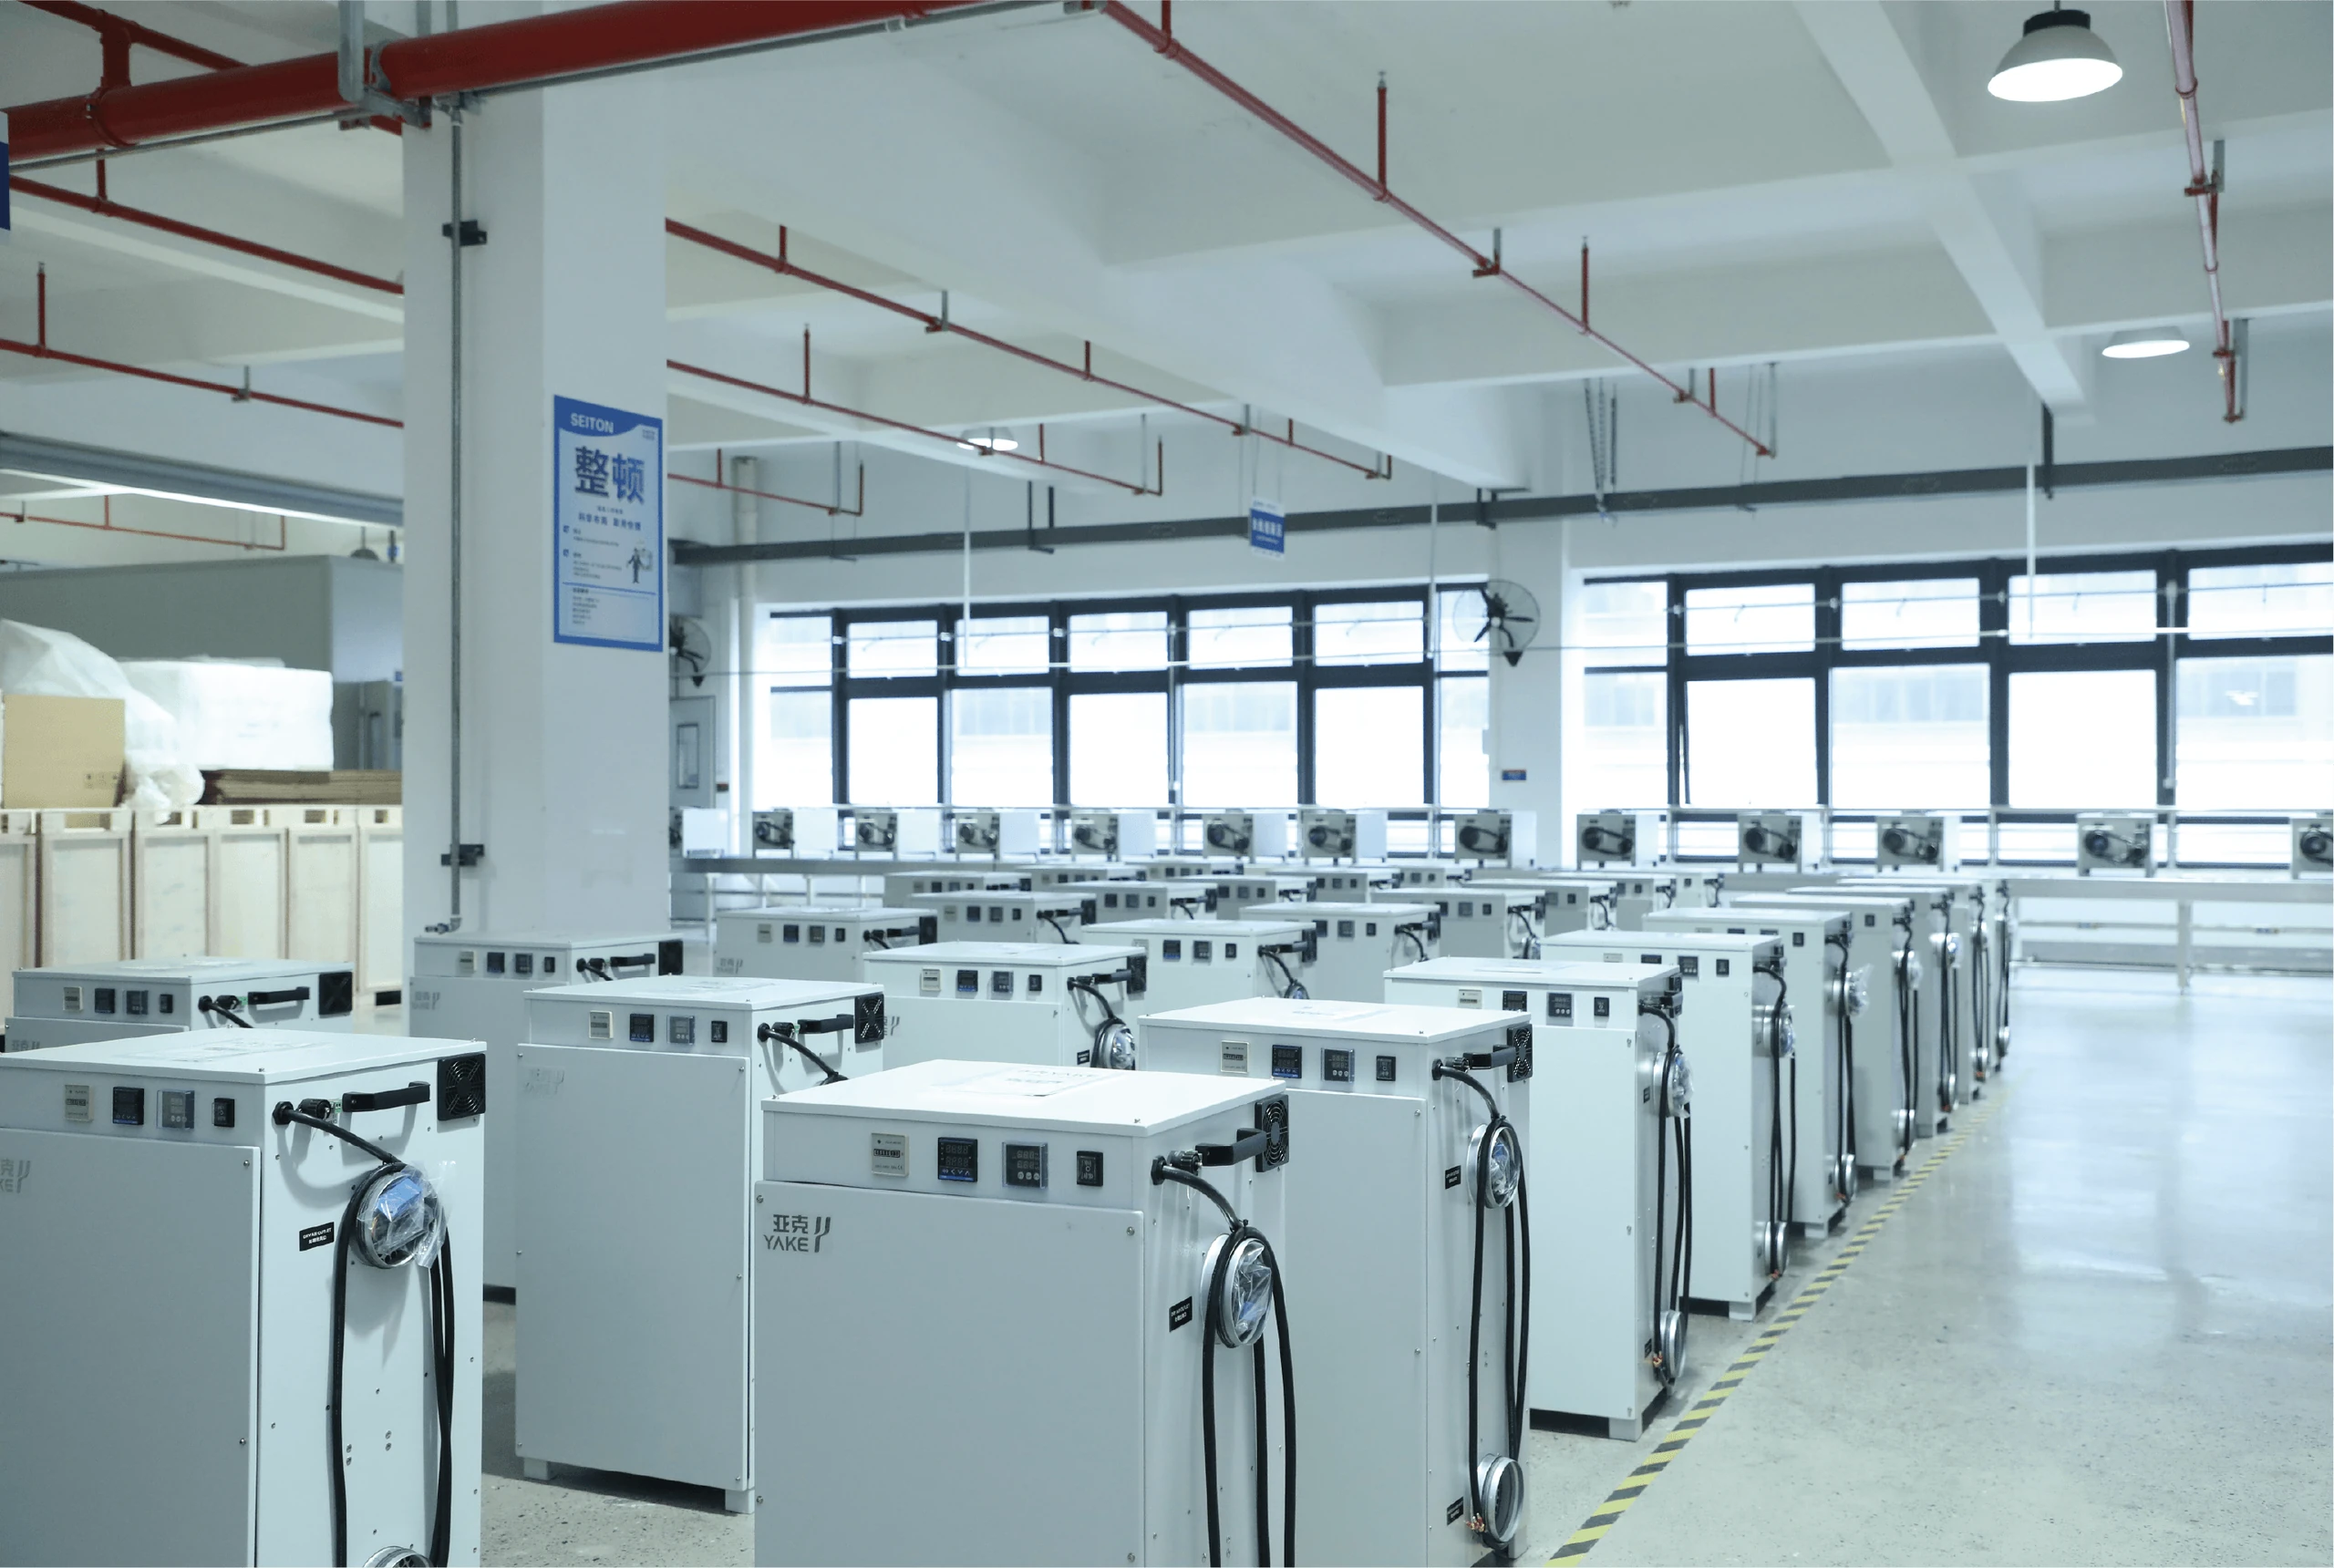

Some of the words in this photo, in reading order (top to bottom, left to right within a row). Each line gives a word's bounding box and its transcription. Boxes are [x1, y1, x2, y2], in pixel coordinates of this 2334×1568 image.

[571, 413, 614, 434] SEITON
[574, 446, 645, 505] 整顿
[773, 1214, 808, 1234] 亚克
[763, 1234, 809, 1253] YAKE
